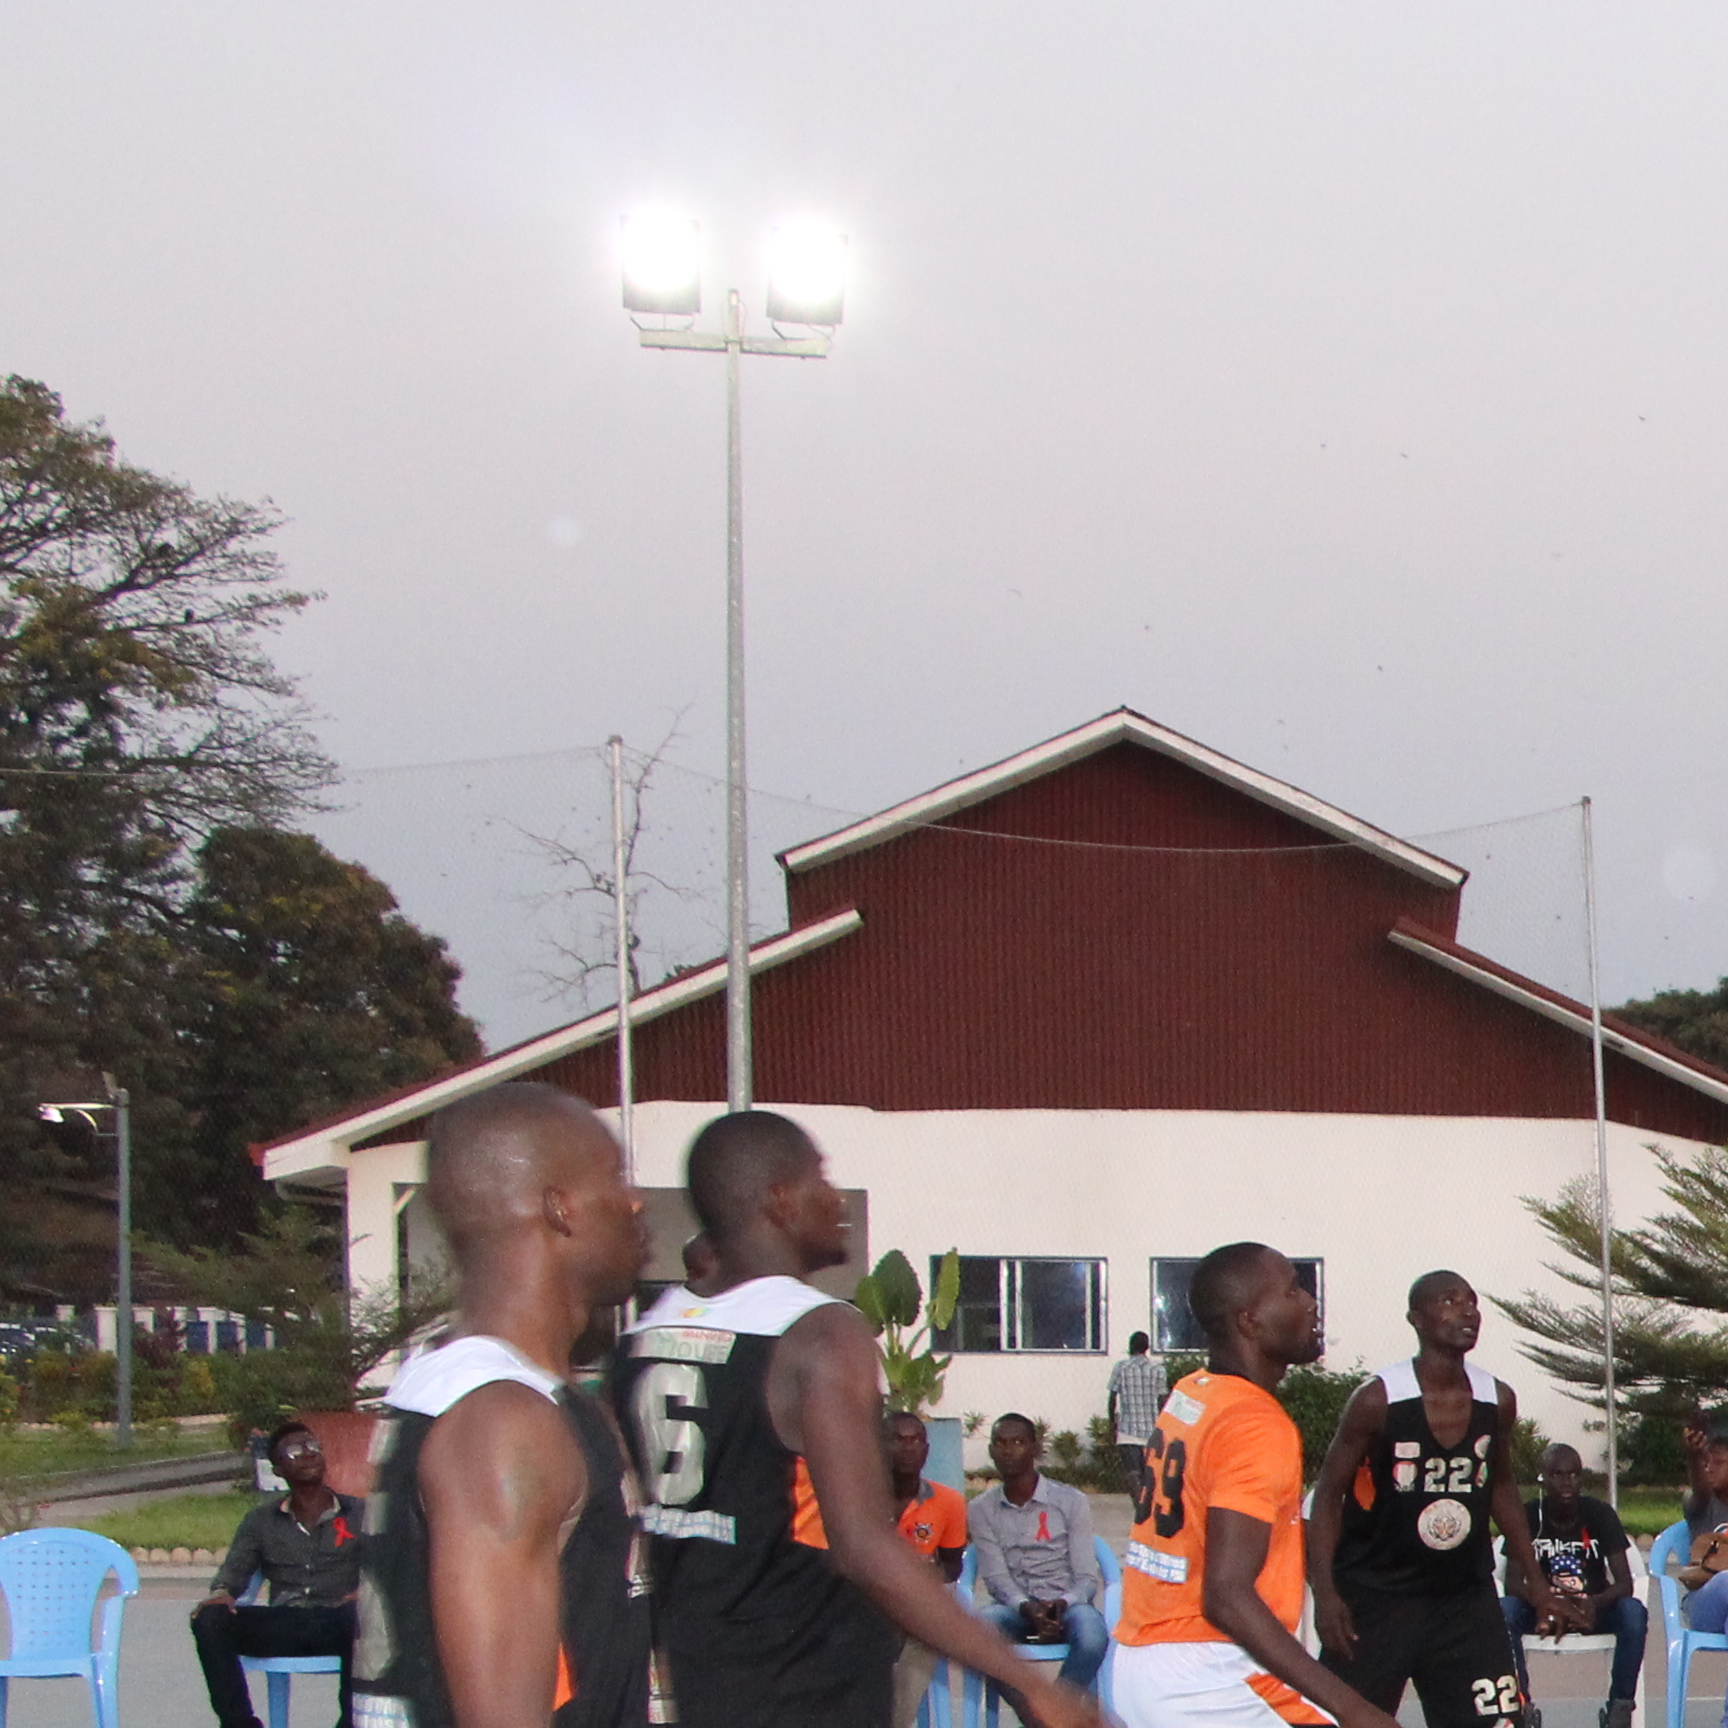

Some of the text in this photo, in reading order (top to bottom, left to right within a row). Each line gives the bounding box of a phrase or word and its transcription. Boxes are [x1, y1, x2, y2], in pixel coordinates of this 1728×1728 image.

[632, 1362, 708, 1505] 6
[1423, 1457, 1473, 1493] 22
[1471, 1674, 1520, 1716] 22
